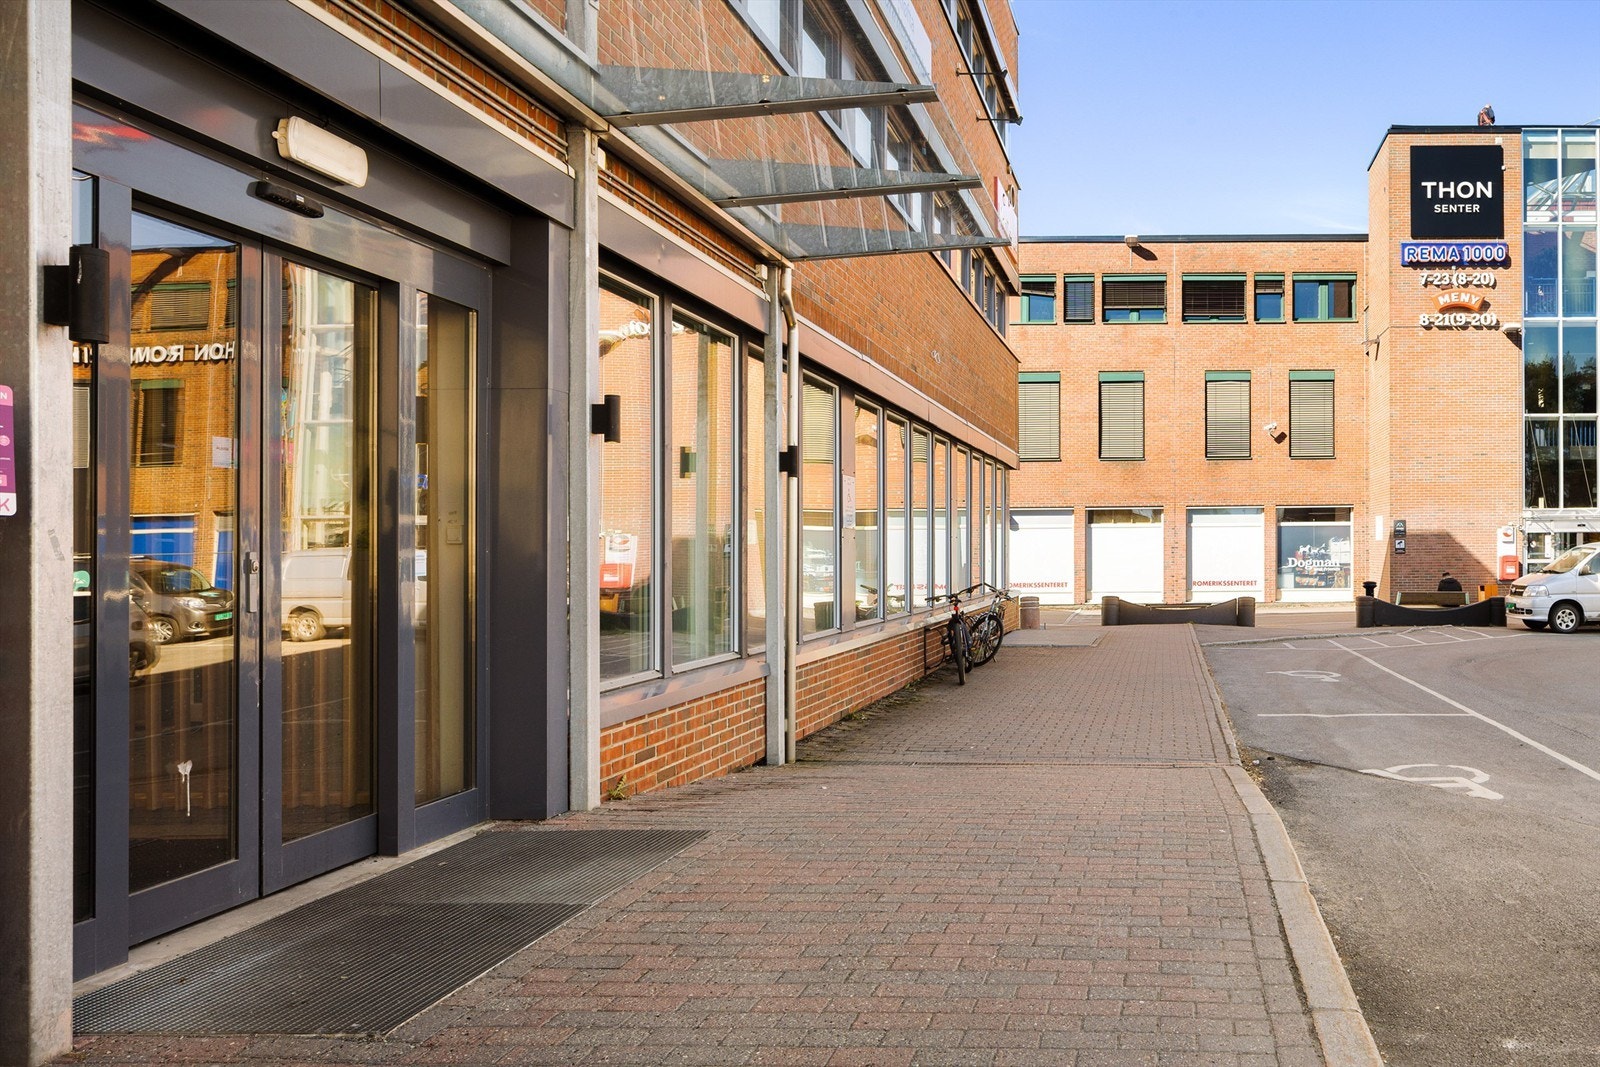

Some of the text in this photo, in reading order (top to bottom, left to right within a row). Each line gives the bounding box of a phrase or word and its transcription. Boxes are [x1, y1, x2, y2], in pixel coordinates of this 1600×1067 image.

[1421, 181, 1493, 199] THON
[1434, 204, 1480, 213] SENTER
[1405, 245, 1506, 263] REMA 1000
[1437, 292, 1480, 306] MENY
[1287, 557, 1340, 570] Dogman
